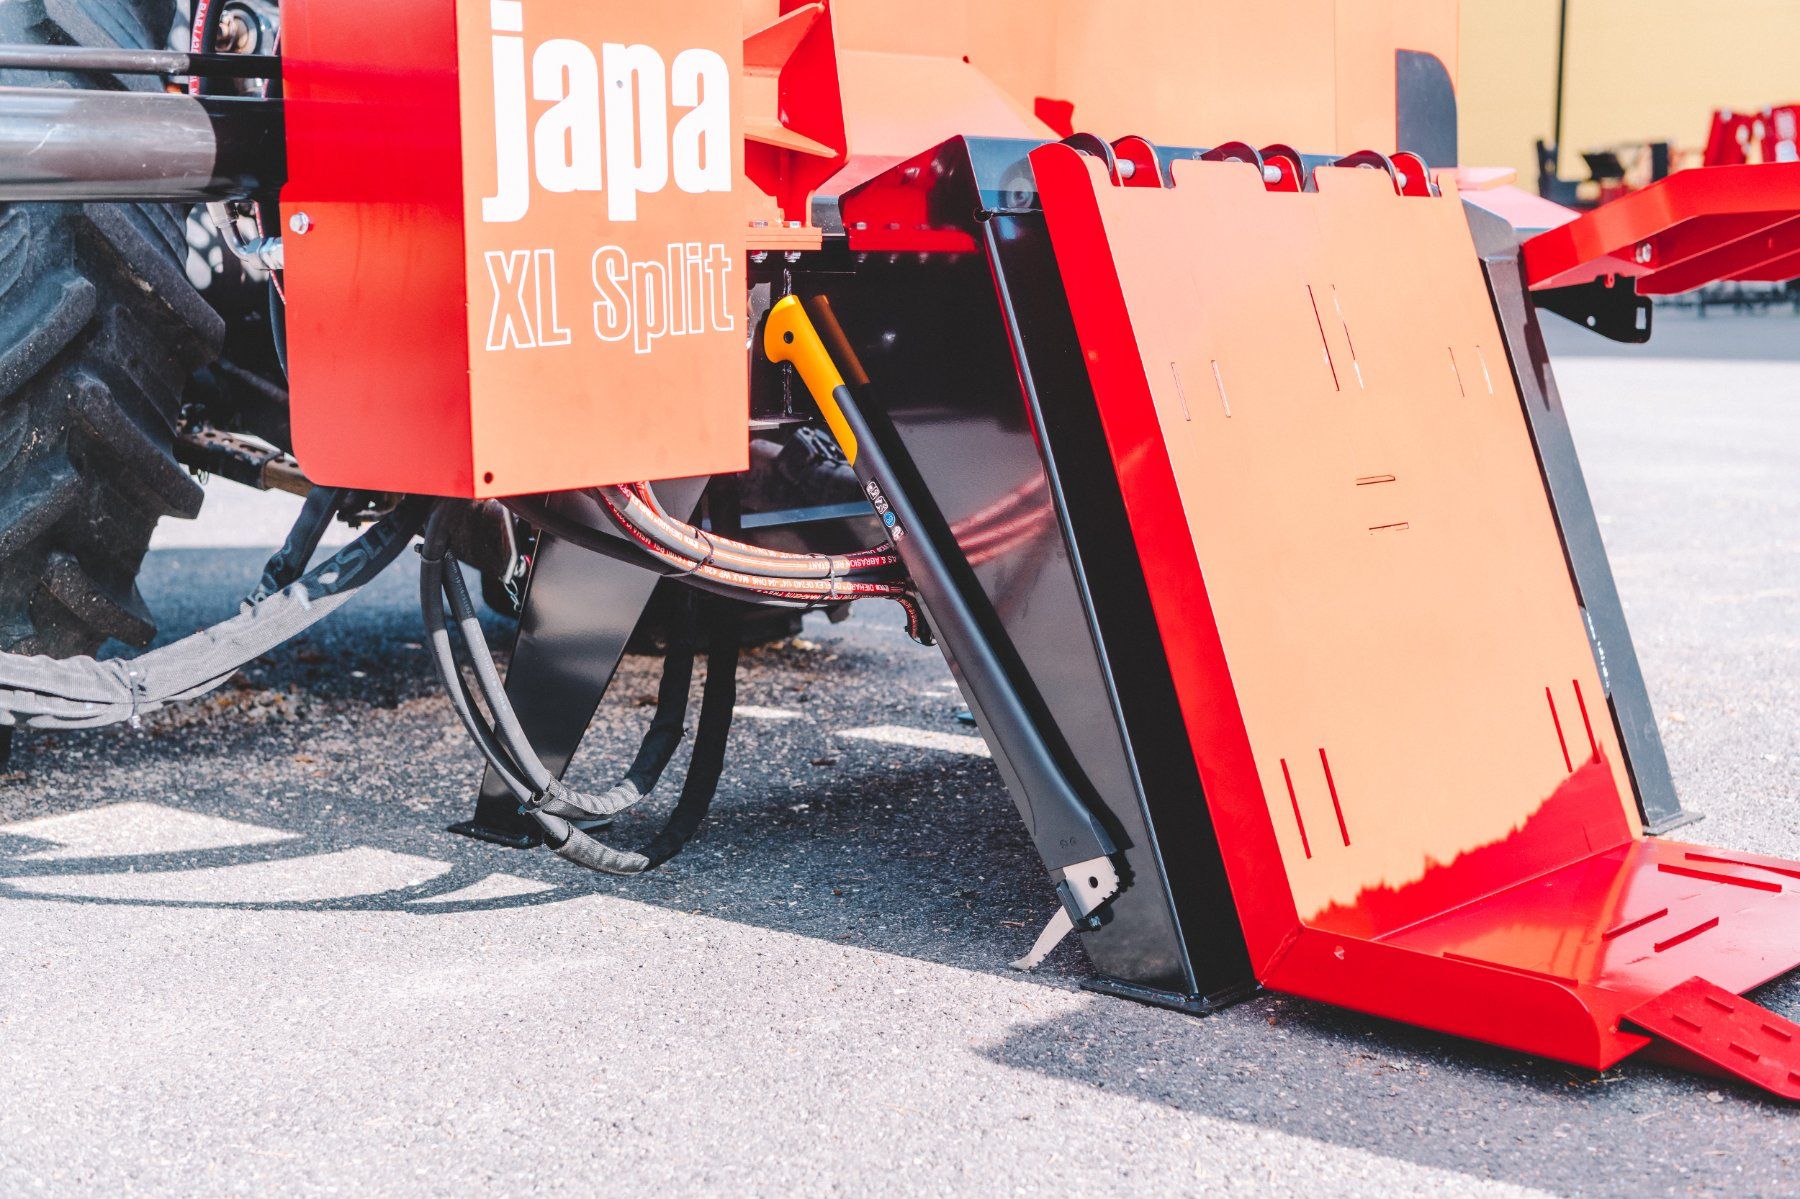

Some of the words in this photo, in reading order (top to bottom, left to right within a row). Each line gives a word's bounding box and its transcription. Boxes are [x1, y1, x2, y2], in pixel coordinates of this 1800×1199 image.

[482, 0, 732, 222] japa
[485, 248, 571, 351] XL
[591, 242, 734, 354] Split
[807, 560, 844, 570] RESTANT
[844, 557, 880, 567] ABRASION
